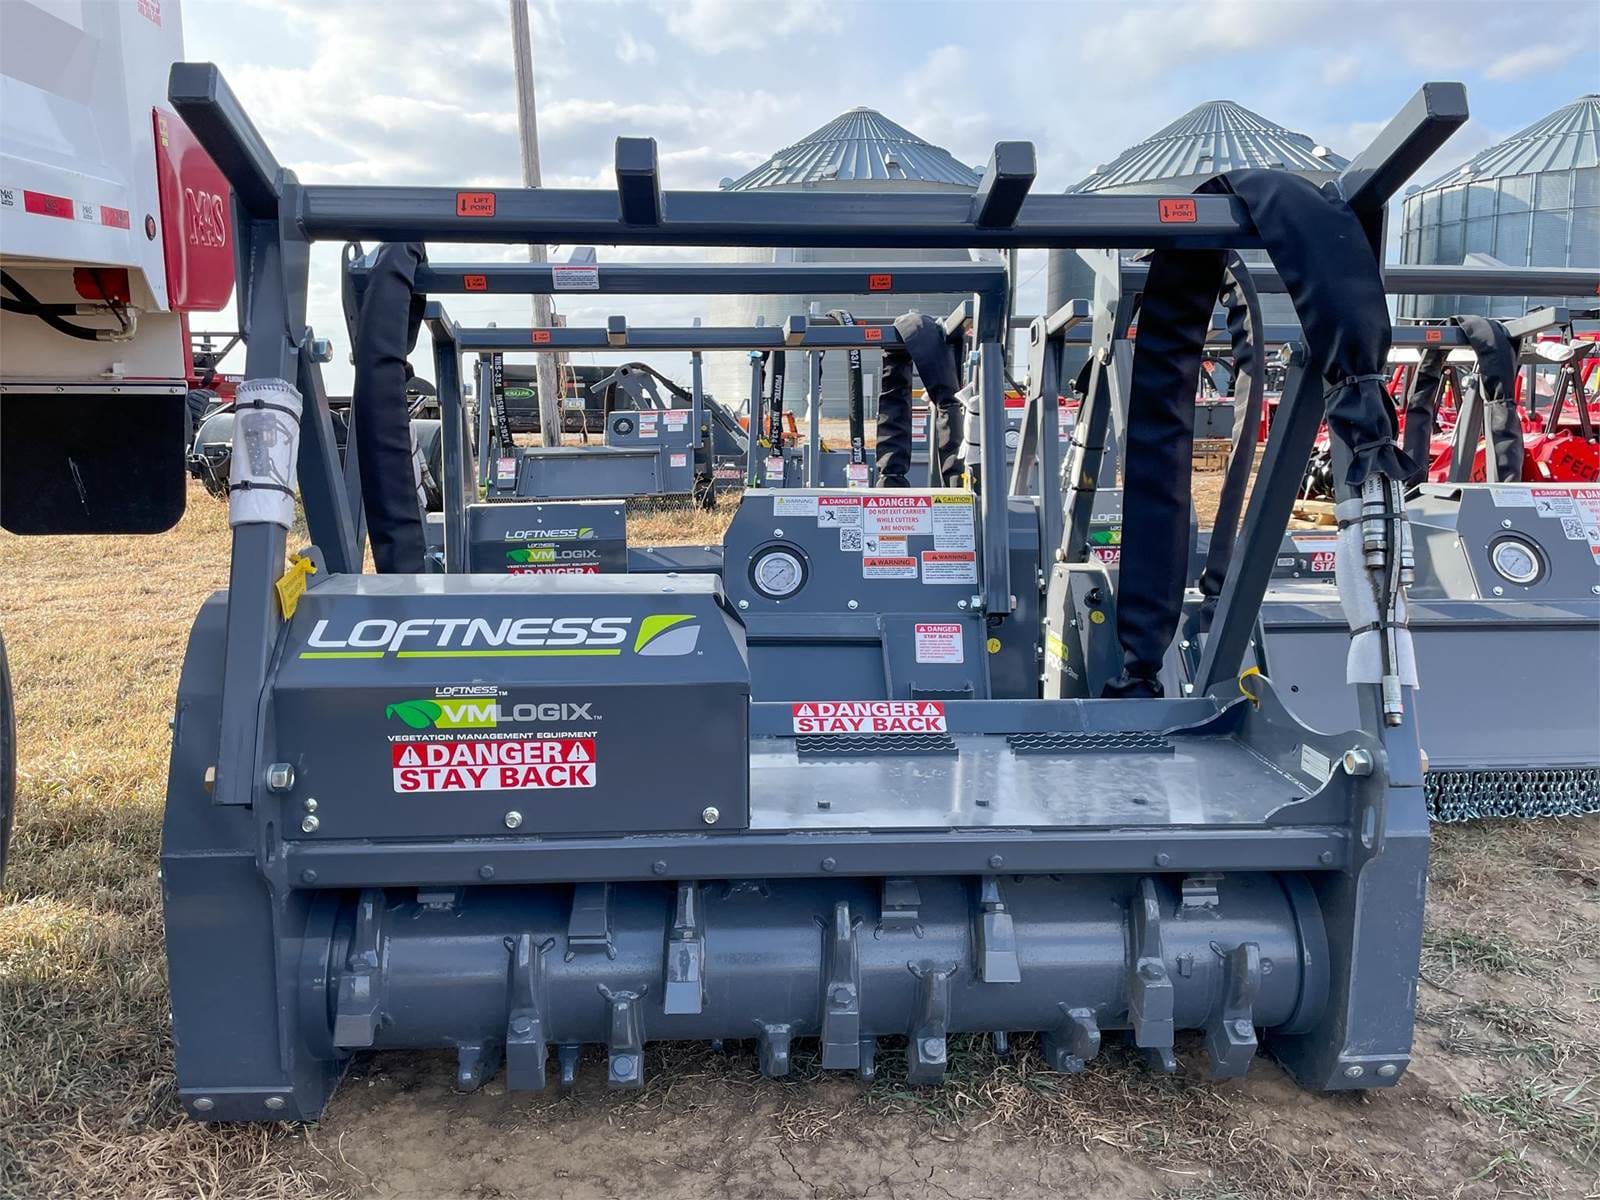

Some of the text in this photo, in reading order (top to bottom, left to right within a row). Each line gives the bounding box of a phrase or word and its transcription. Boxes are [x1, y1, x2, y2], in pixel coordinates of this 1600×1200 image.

[184, 187, 226, 247] MAS
[1585, 490, 1600, 499] DAN
[880, 498, 915, 507] DANGER
[505, 528, 578, 539] LOFTNESS
[530, 550, 597, 559] VMLOGIX
[307, 617, 632, 651] LOFTNESS
[435, 686, 498, 695] LOFTNESS
[442, 703, 593, 722] VMLOGIX
[817, 702, 919, 717] DANGER
[798, 717, 942, 732] STAY BACK
[387, 731, 598, 742] VEGETATION MANAGEMENT EQUIPMENT
[427, 742, 563, 766] DANGER
[400, 765, 590, 791] STAY BACK
